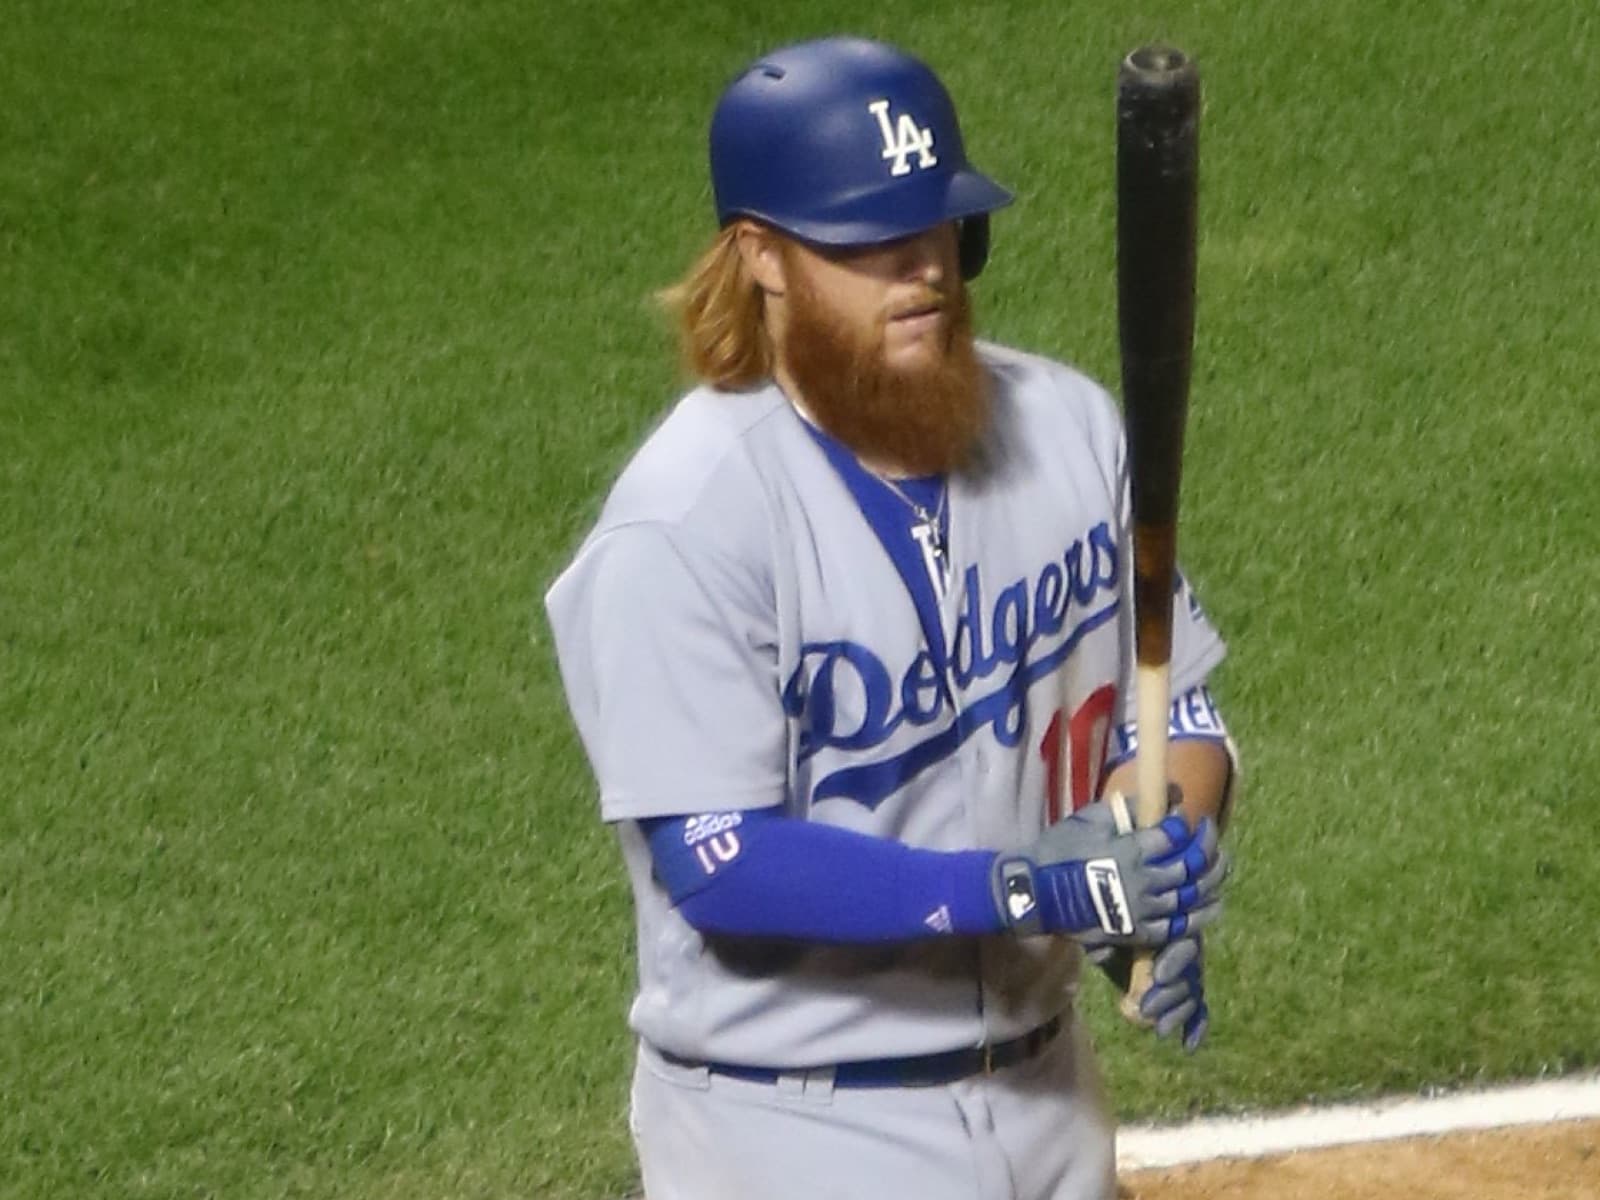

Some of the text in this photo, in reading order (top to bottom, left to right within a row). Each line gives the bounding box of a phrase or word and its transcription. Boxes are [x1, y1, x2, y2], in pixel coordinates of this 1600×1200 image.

[868, 100, 937, 177] LA
[782, 521, 1121, 763] Dodgers
[1039, 682, 1117, 826] 10
[684, 811, 743, 847] adidas
